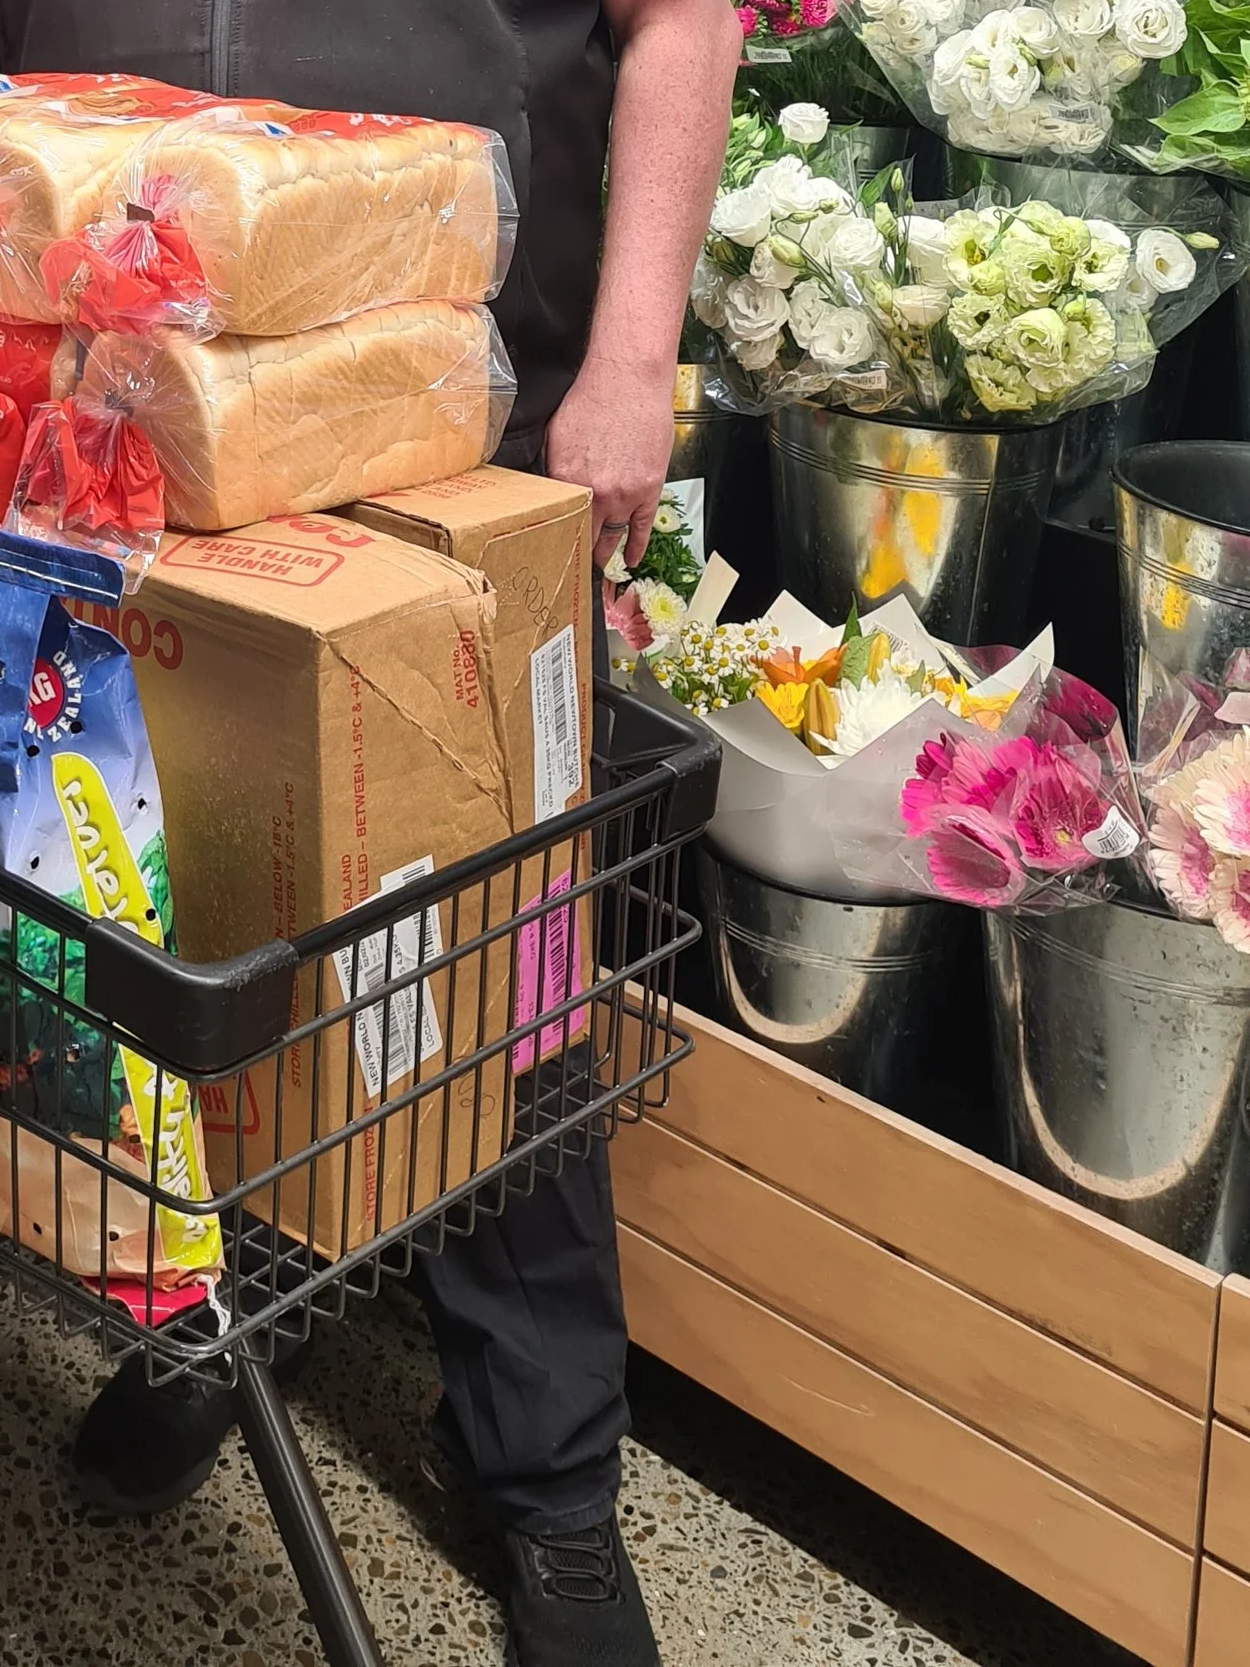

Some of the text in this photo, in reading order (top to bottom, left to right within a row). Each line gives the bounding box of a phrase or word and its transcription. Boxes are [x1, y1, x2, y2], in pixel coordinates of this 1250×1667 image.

[191, 539, 325, 569] WITH CARE
[197, 552, 293, 576] HANDLE
[47, 651, 82, 742] ZEALAND
[352, 700, 362, 714] &
[453, 671, 464, 700] MAT
[354, 761, 367, 838] BETWEEN
[273, 858, 283, 913] BELOW
[342, 854, 352, 911] EALAND
[358, 1022, 380, 1086] NEW WORLD
[365, 1168, 376, 1222] STORE
